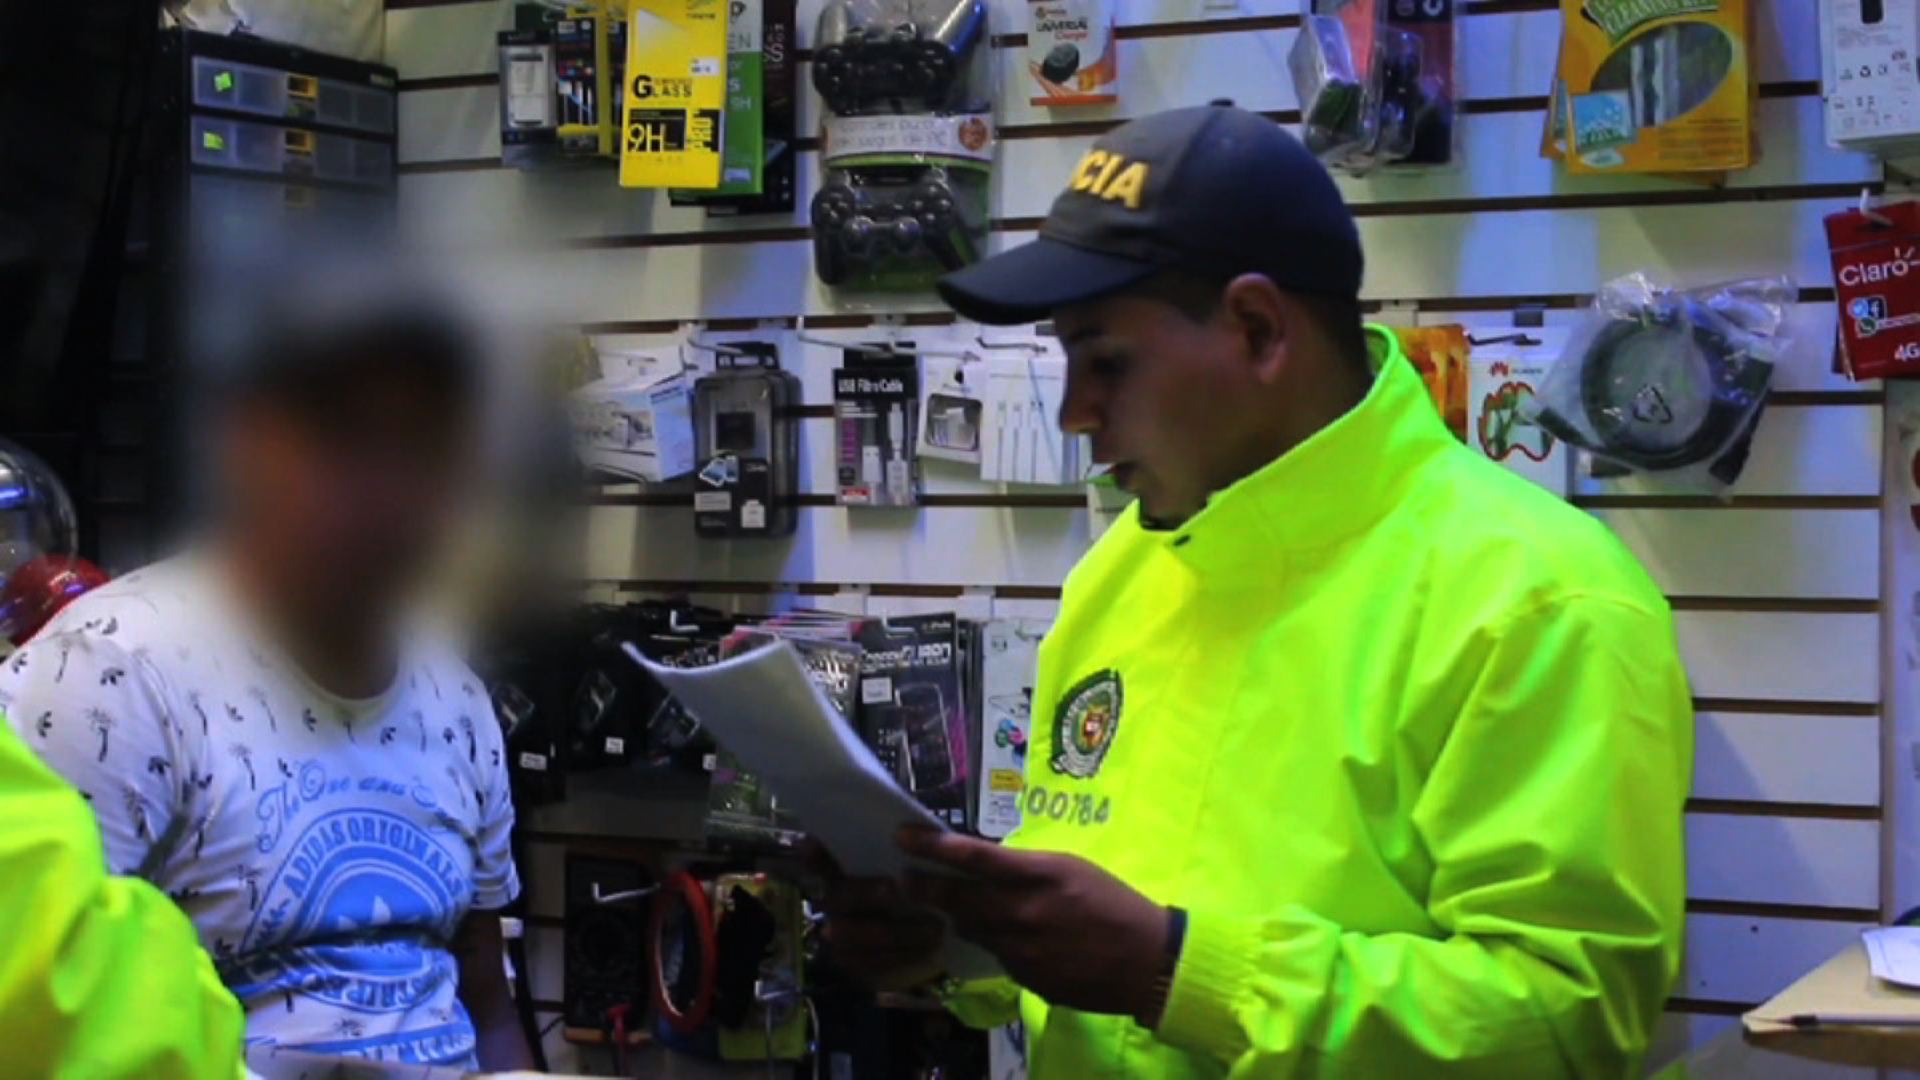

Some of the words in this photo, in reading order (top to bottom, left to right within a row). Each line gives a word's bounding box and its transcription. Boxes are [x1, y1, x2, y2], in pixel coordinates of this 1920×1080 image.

[629, 123, 667, 152] 9H
[1839, 258, 1909, 286] Claro
[283, 820, 346, 898] ADIDAS
[348, 815, 465, 896] ORIGINALS
